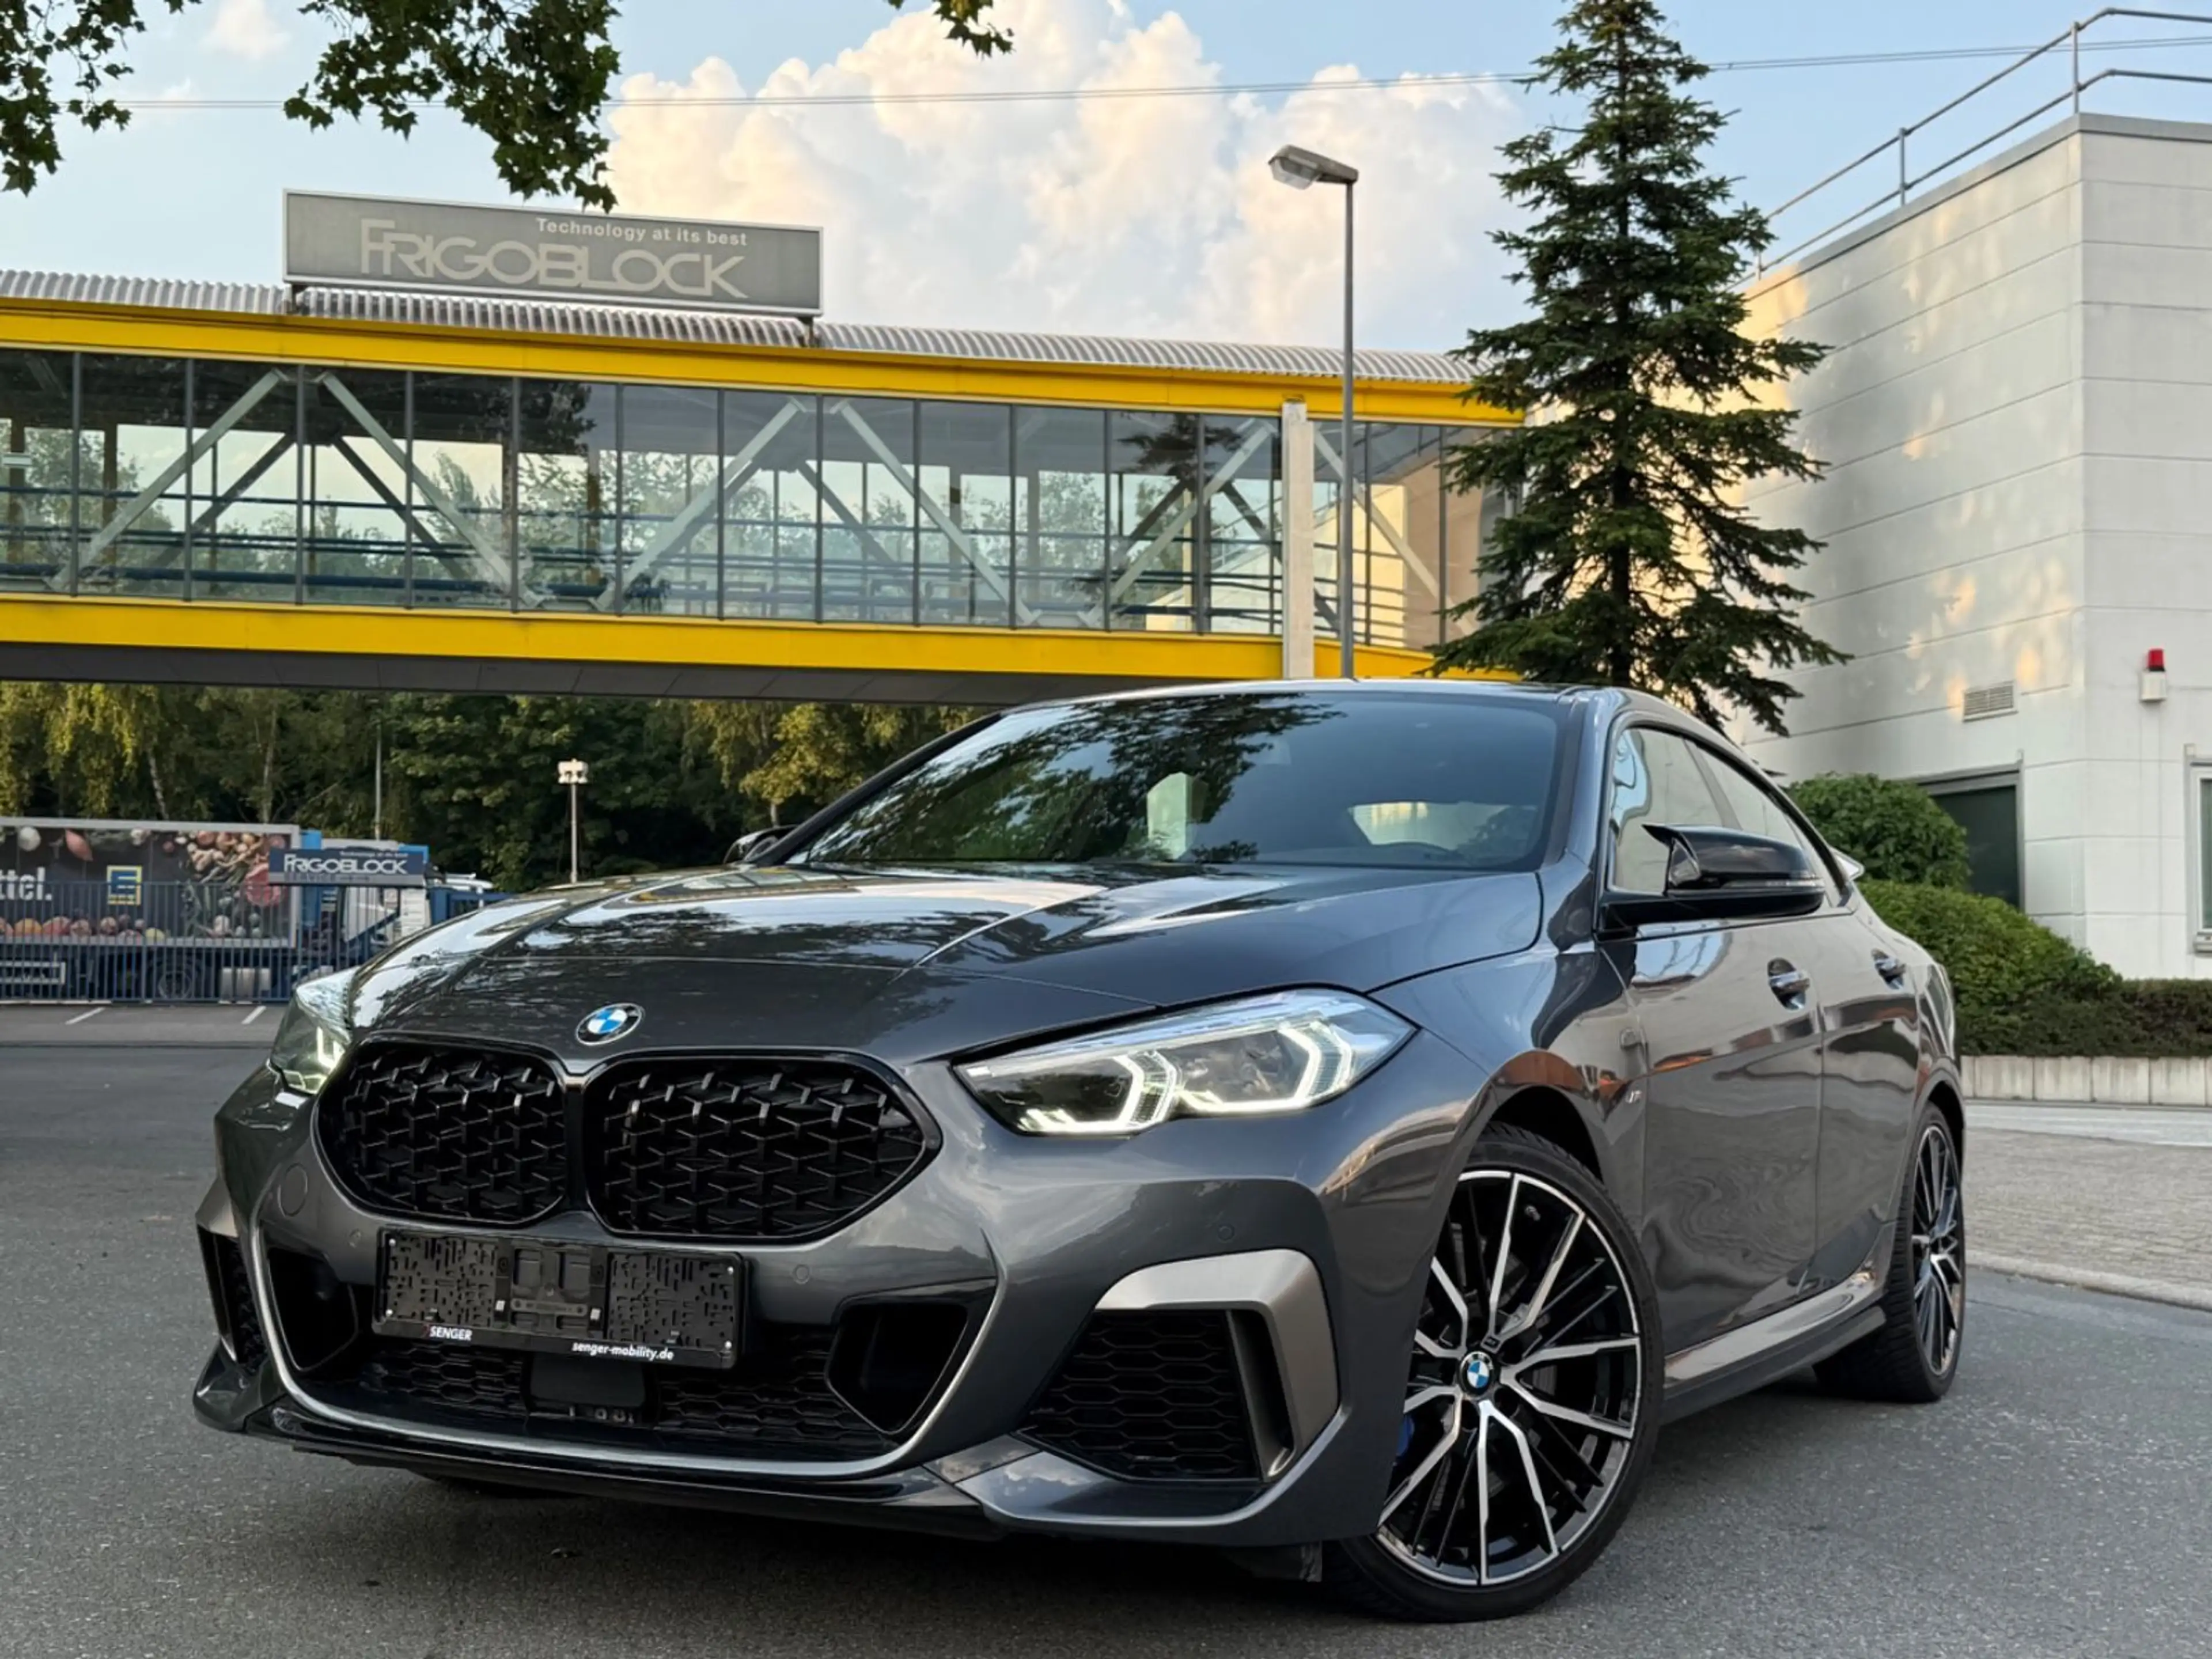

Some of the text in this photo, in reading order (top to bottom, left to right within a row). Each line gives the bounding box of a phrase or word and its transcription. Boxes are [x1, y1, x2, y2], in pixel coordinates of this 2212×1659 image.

[536, 218, 748, 246] Technology at its best
[361, 218, 748, 298] FRIGOBLOCK
[283, 853, 408, 874] FRIGOBLOCK
[429, 1325, 473, 1341] SENGER
[571, 1342, 675, 1361] senger-mobility.de
